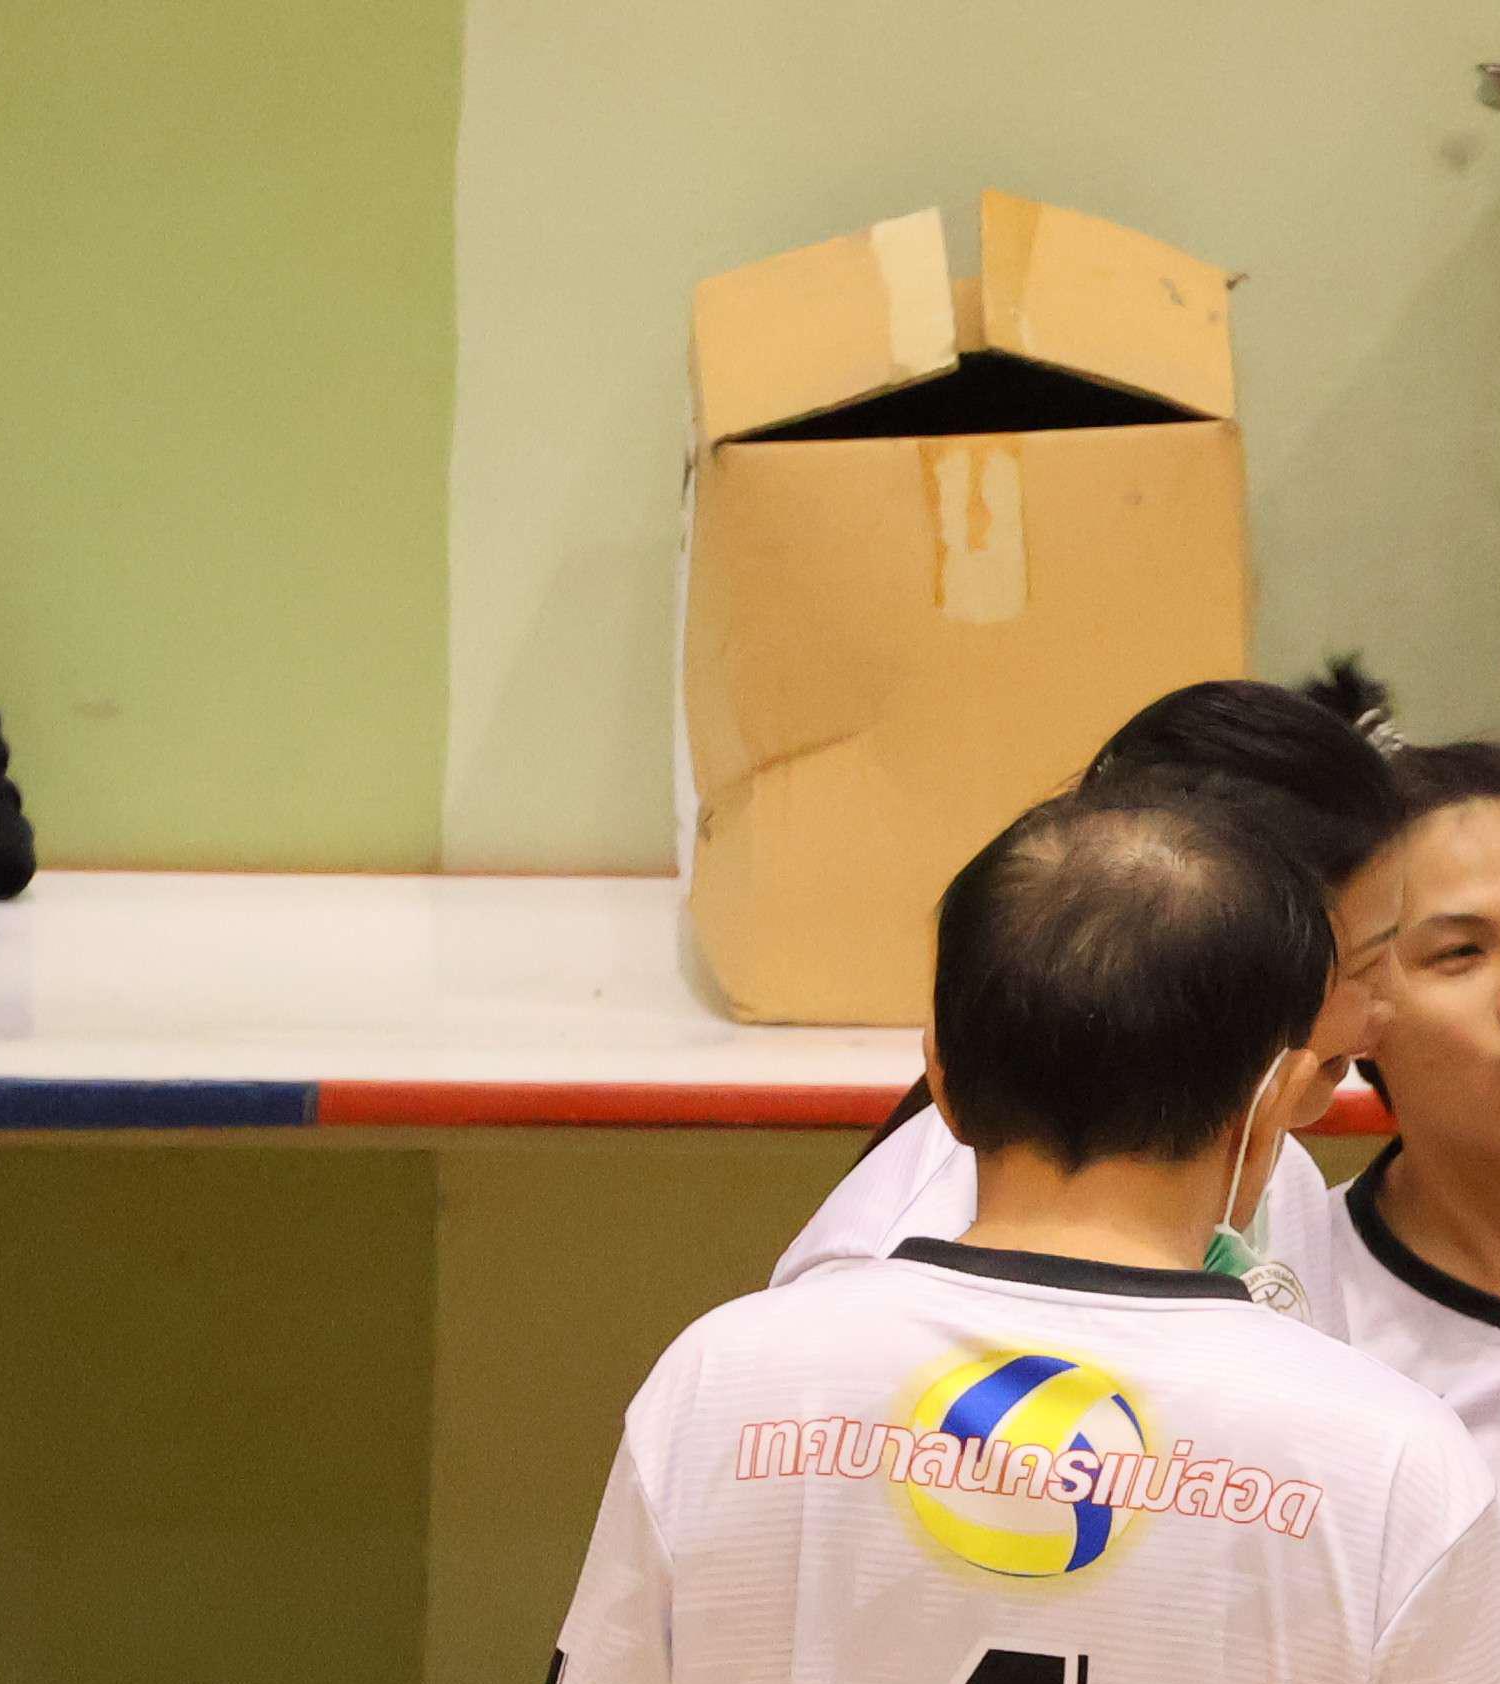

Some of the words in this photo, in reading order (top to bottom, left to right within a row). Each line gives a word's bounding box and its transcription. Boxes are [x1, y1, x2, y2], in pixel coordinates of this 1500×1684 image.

[736, 1416, 1324, 1539] เทศบาลนครแม่สอด
